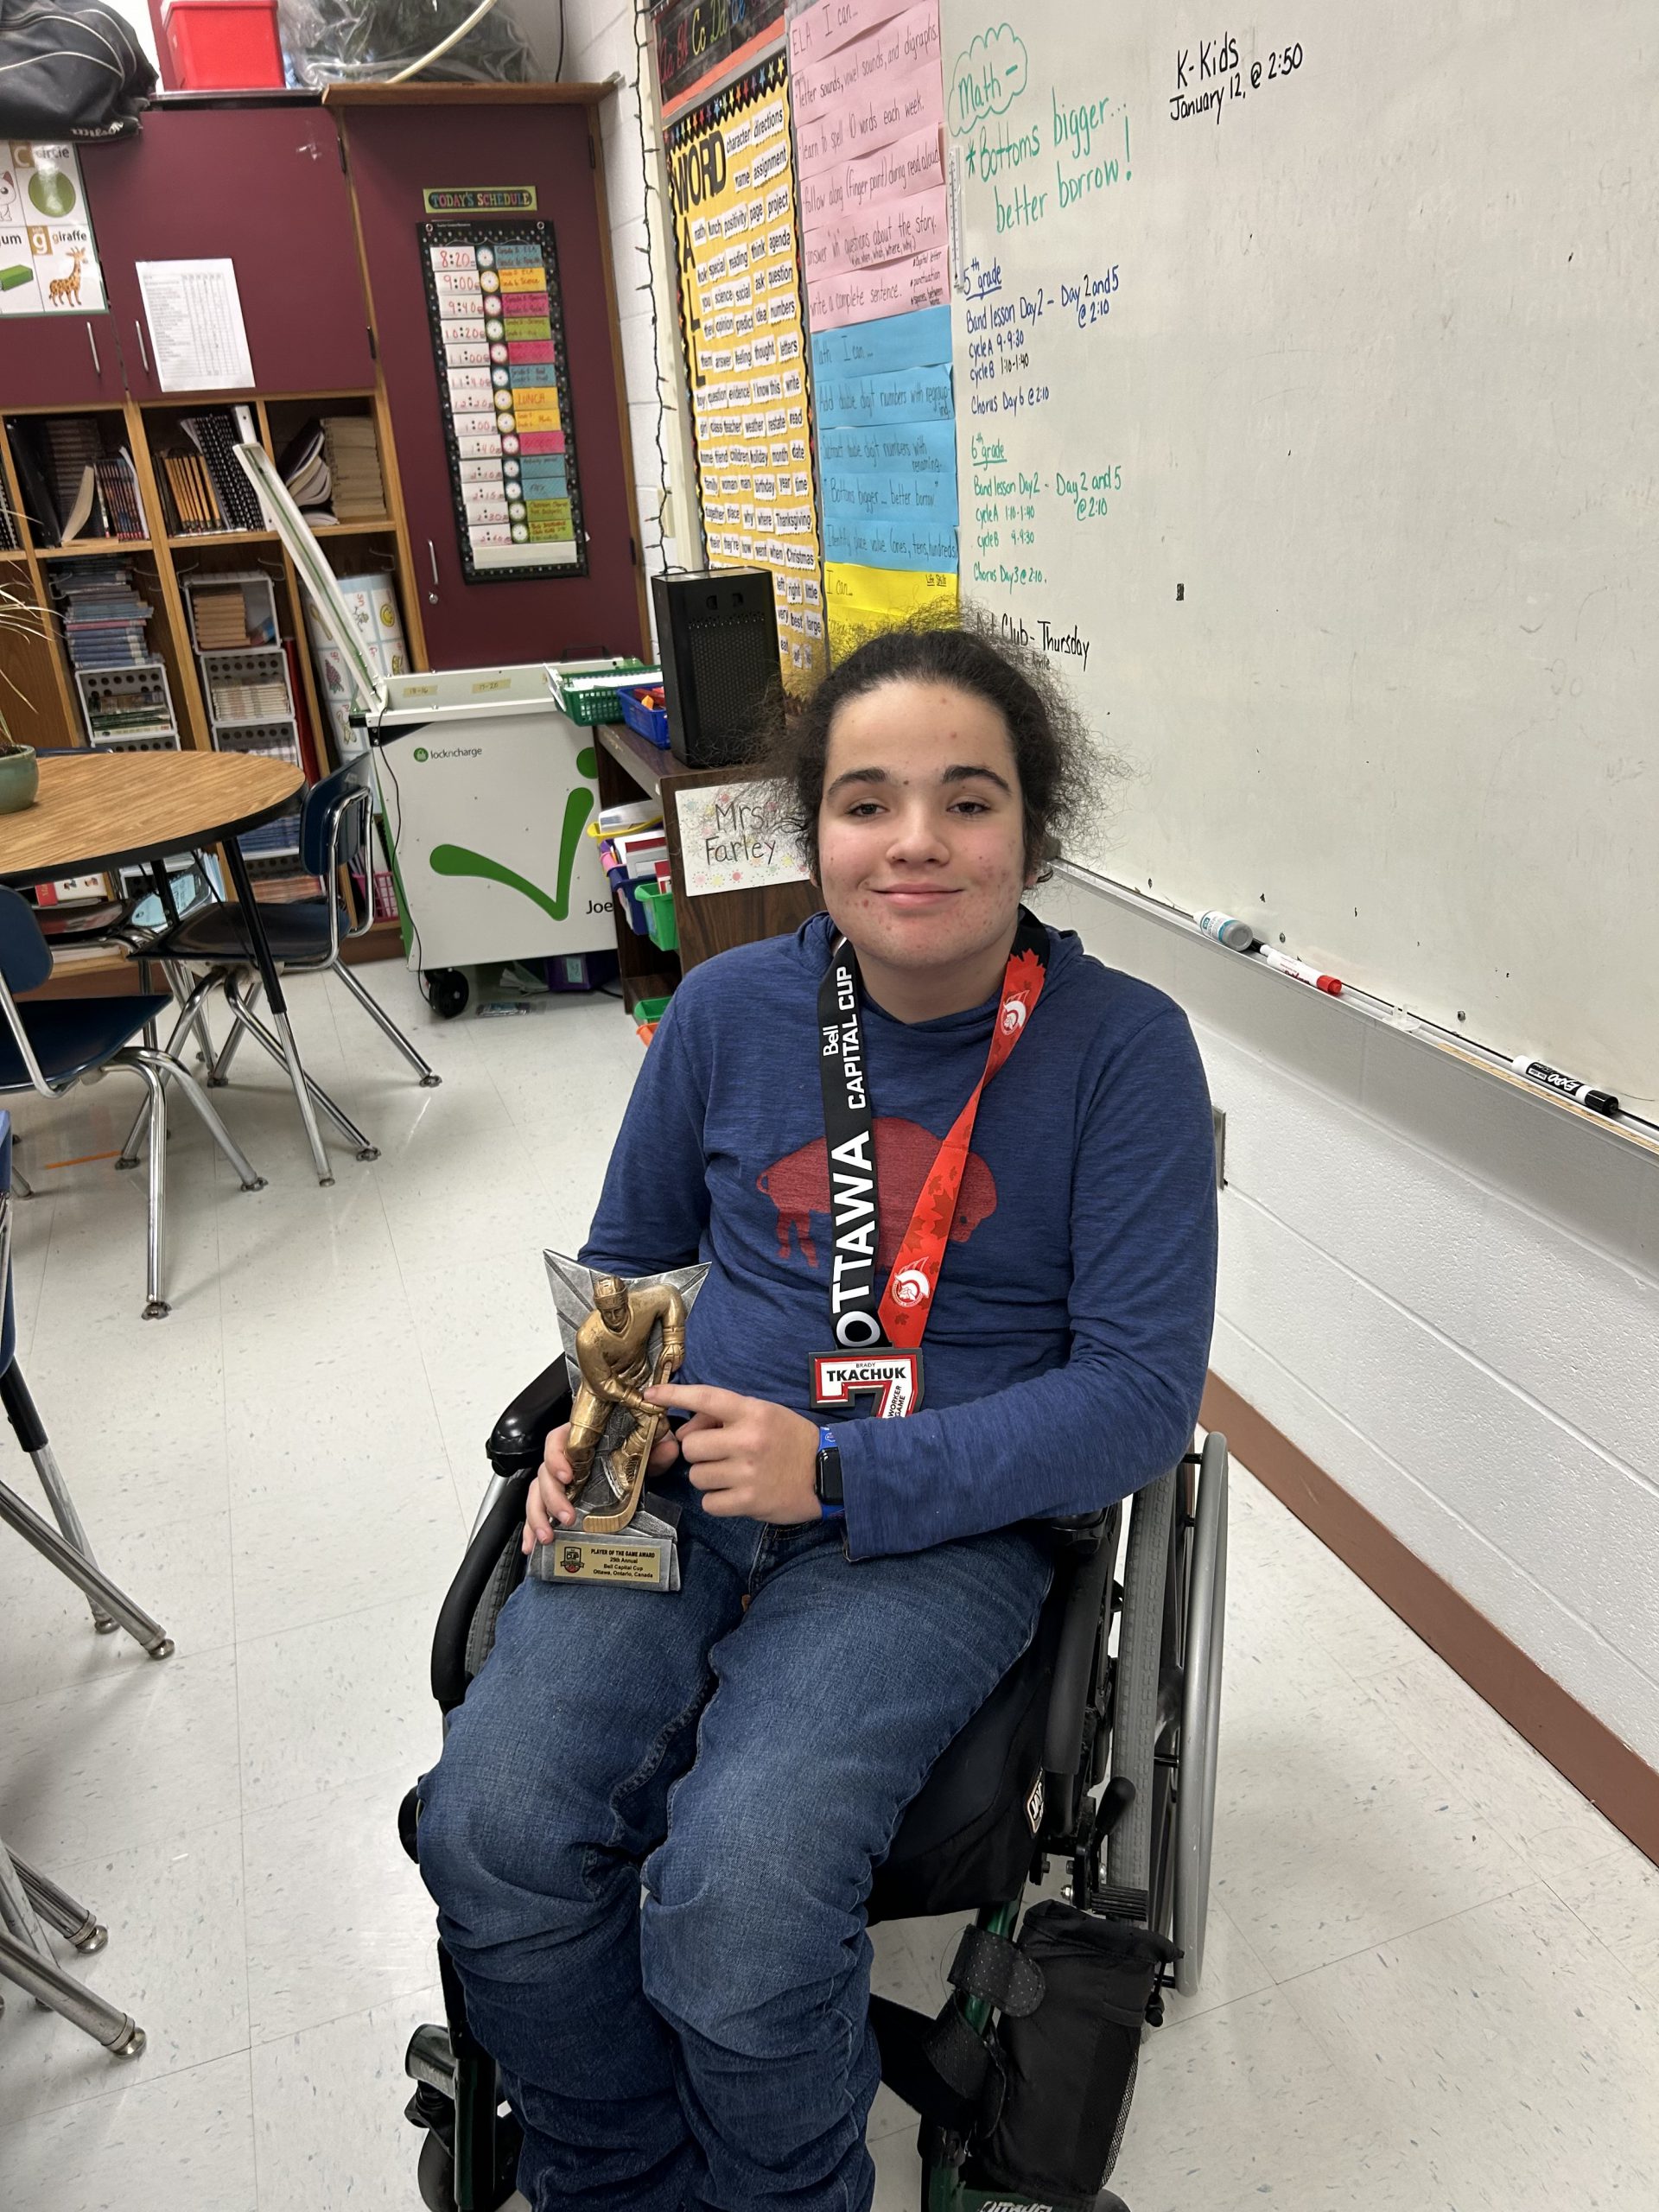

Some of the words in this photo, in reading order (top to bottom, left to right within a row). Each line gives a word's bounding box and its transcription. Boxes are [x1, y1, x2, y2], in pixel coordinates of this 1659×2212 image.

[861, 40, 887, 76] sounds,
[888, 31, 899, 64] and
[1177, 31, 1239, 89] K-Kids
[958, 66, 1001, 119] Math
[1170, 86, 1224, 124] January
[1250, 61, 1263, 89] @
[1268, 42, 1303, 81] 2:50
[753, 110, 783, 138] directions
[860, 102, 878, 132] words
[884, 98, 900, 124] each
[673, 130, 726, 216] WORD
[753, 148, 786, 177] assignment
[907, 144, 920, 176] read
[734, 170, 750, 188] name
[432, 192, 474, 208] TODAY'S
[477, 192, 530, 207] SCHEDULE
[749, 203, 763, 222] page
[768, 192, 789, 218] project
[995, 181, 1048, 233] better
[52, 231, 87, 246] giraffe
[769, 230, 791, 252] agenda
[873, 216, 893, 245] about
[899, 213, 911, 235] the
[768, 266, 792, 287] question
[977, 257, 1003, 300] grade
[715, 289, 733, 302] science
[736, 283, 751, 301] social
[966, 306, 988, 334] Band
[990, 302, 1015, 331] lesson
[1061, 283, 1081, 313] Day
[1084, 274, 1092, 297] 2
[1092, 268, 1111, 296] and
[1111, 264, 1120, 291] 5
[771, 300, 796, 318] numbers
[1077, 306, 1086, 328] @
[1090, 298, 1110, 323] 2:10
[779, 340, 798, 357] letters
[971, 394, 998, 416] Chorus
[1027, 388, 1035, 406] @
[1035, 385, 1050, 404] 2:10
[982, 437, 1005, 471] grade
[795, 477, 808, 493] time
[974, 474, 993, 497] Band
[994, 475, 1015, 497] lesson
[1056, 472, 1079, 505] Day
[1080, 472, 1088, 492] 2
[1091, 465, 1111, 491] and
[1114, 465, 1122, 491] 5
[775, 511, 811, 531] Thanksgiving
[1077, 499, 1086, 522] @
[1089, 497, 1108, 518] 2:10
[786, 548, 814, 567] Christmas
[974, 561, 997, 583] Chorus
[790, 613, 804, 630] best
[806, 615, 821, 636] large
[1037, 620, 1090, 671] Thursday
[430, 747, 482, 760] lockncharge
[705, 834, 776, 866] Farley
[836, 966, 855, 1011] CUP
[823, 1024, 840, 1057] Bell
[842, 1014, 867, 1110] CAPITAL
[1548, 1074, 1580, 1091] EXPO
[831, 1130, 881, 1347] OTTAWA
[827, 1367, 906, 1382] TKACHUK
[887, 1385, 902, 1417] WORKER
